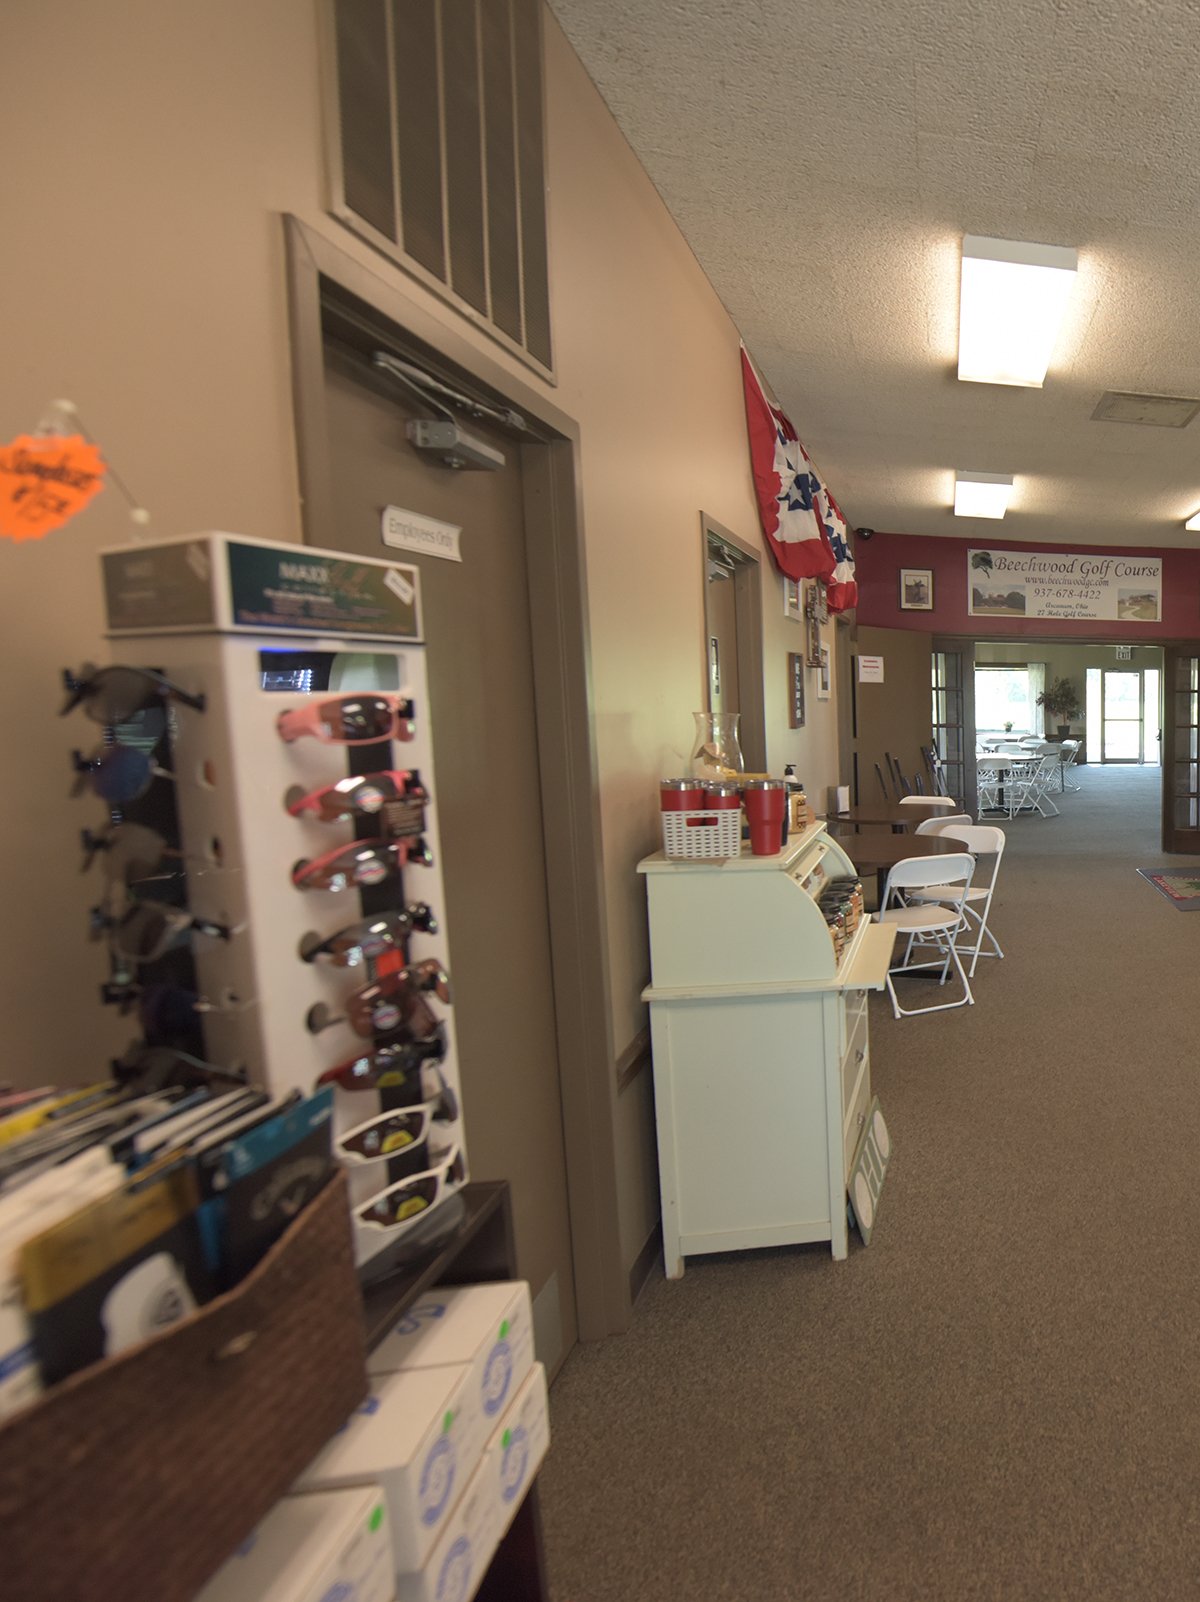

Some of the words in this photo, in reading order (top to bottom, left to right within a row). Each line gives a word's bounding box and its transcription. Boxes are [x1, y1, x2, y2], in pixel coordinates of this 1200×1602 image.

[388, 517, 435, 543] Employees
[436, 531, 453, 551] Only
[994, 556, 1078, 574] Beechwood
[1080, 559, 1113, 578] Golf
[1114, 562, 1160, 577] Course
[1025, 574, 1109, 588] www.beechwoodgc.com
[1034, 588, 1101, 600] 937-678-4422
